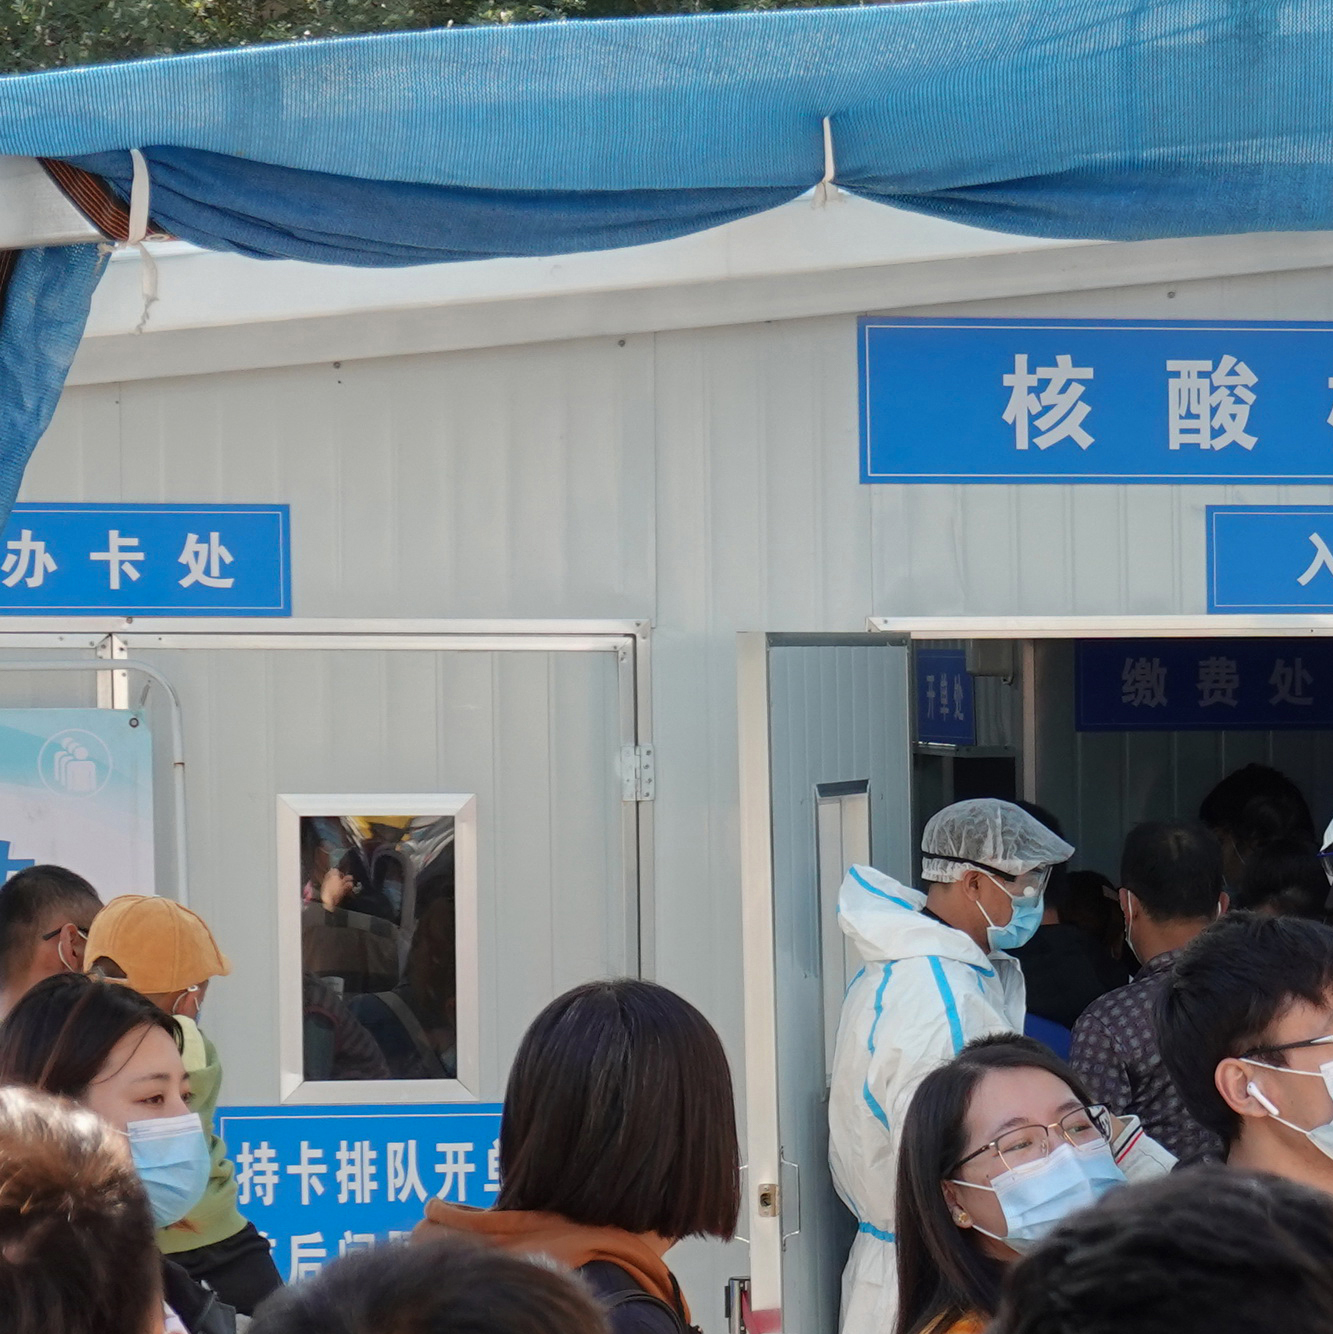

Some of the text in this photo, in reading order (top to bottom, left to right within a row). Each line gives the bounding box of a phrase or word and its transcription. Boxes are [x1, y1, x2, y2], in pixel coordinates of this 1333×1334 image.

[1, 528, 236, 590] 办卡处
[1120, 656, 1314, 708] 缴费处
